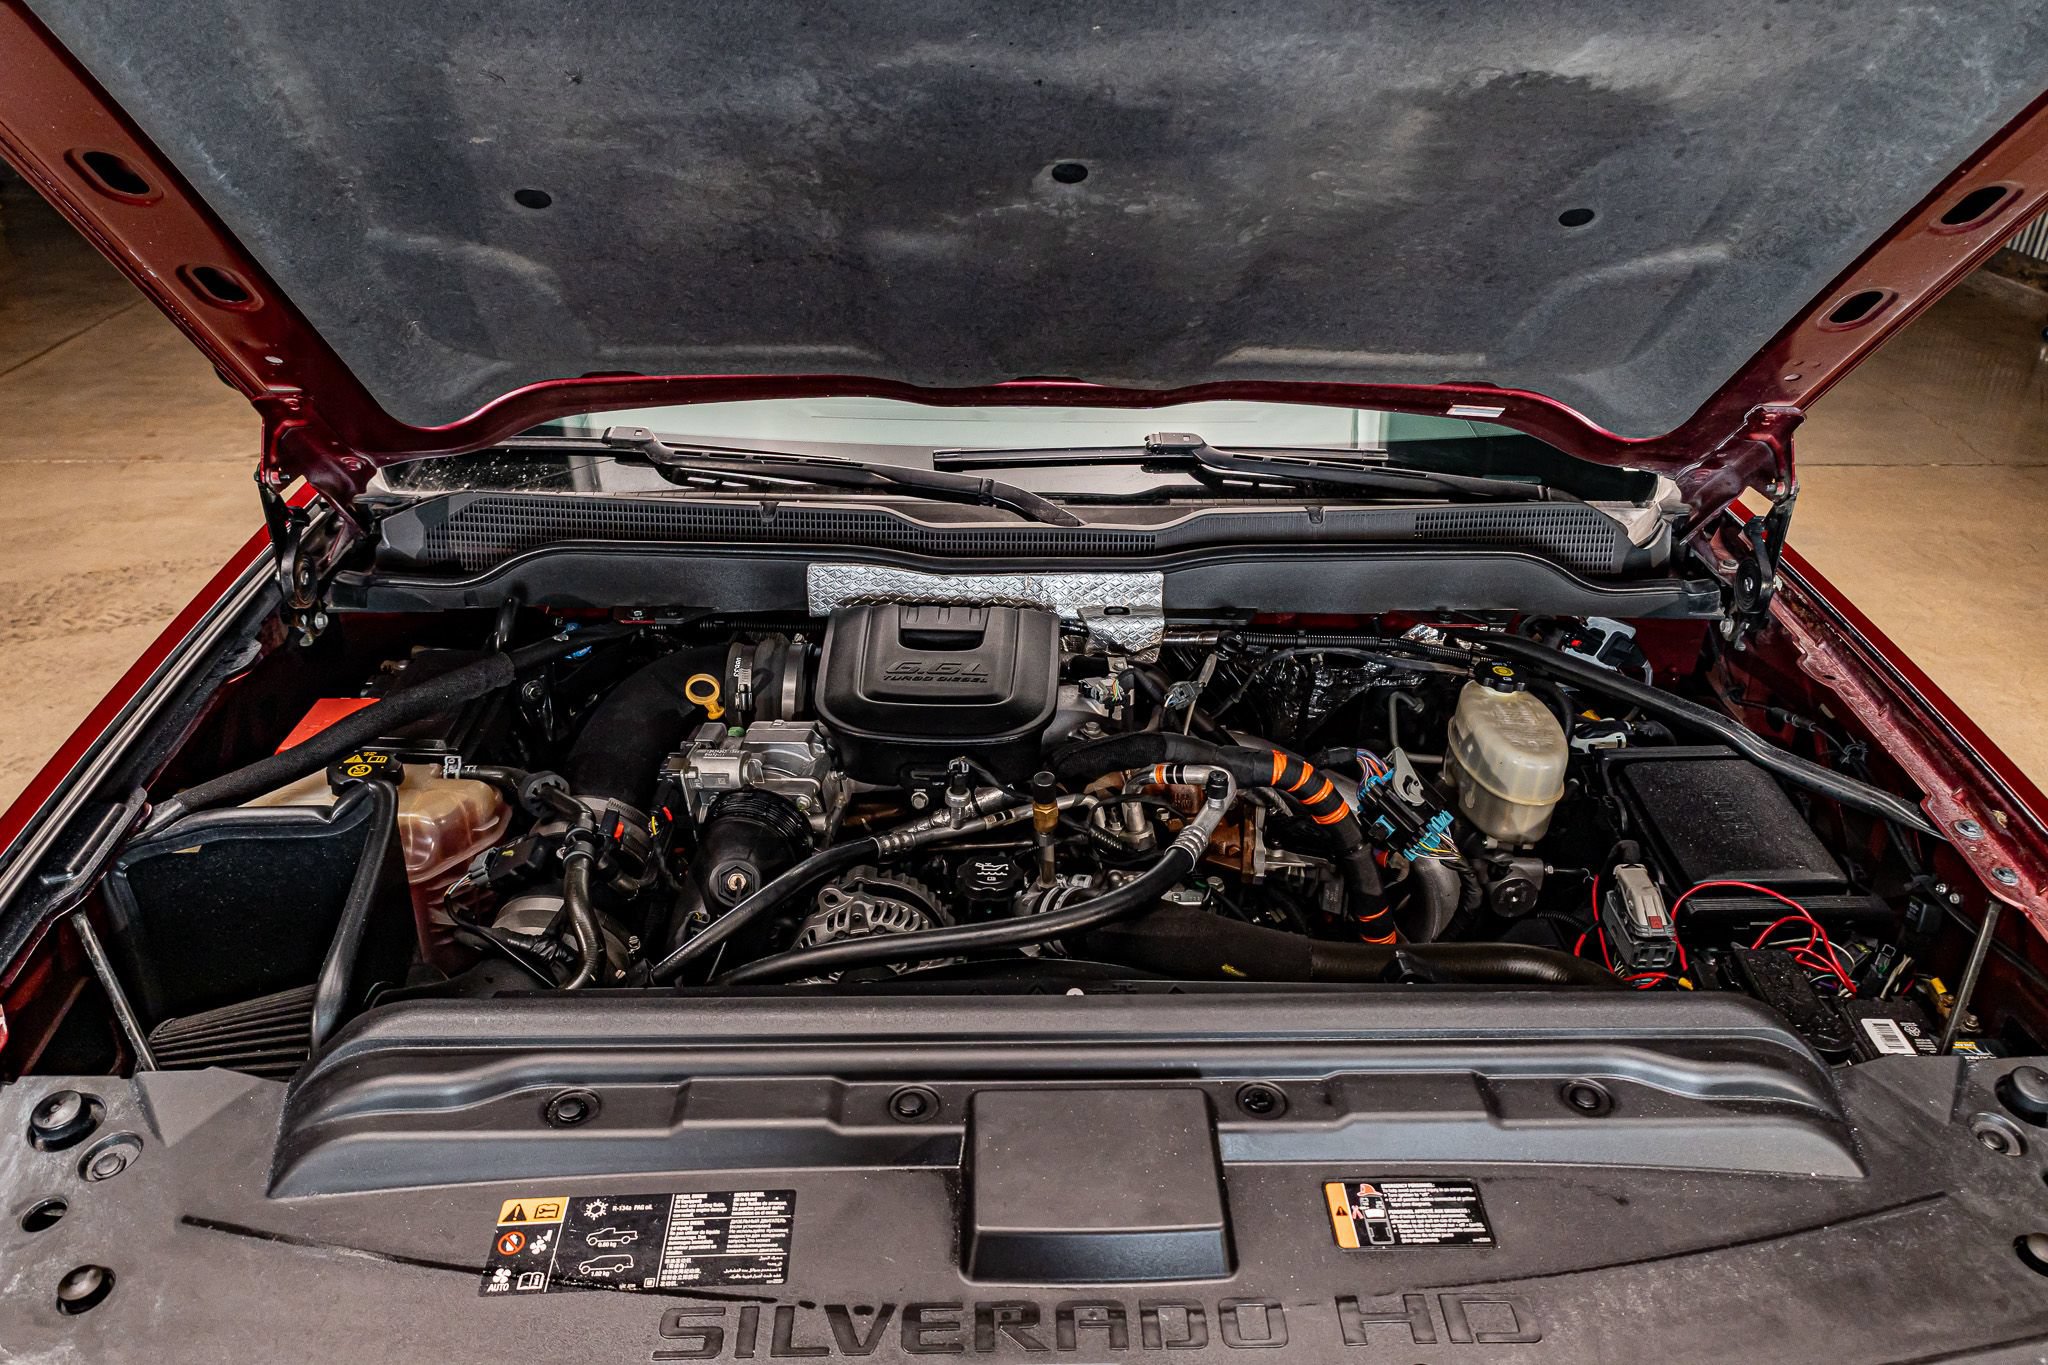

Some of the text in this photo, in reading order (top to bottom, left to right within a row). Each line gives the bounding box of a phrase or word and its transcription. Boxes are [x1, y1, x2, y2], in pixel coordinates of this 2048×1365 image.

[885, 661, 989, 676] 6.6L
[936, 675, 988, 683] DIESEL
[486, 1283, 510, 1292] AUTO
[652, 1293, 1542, 1361] SILVERADO HD
